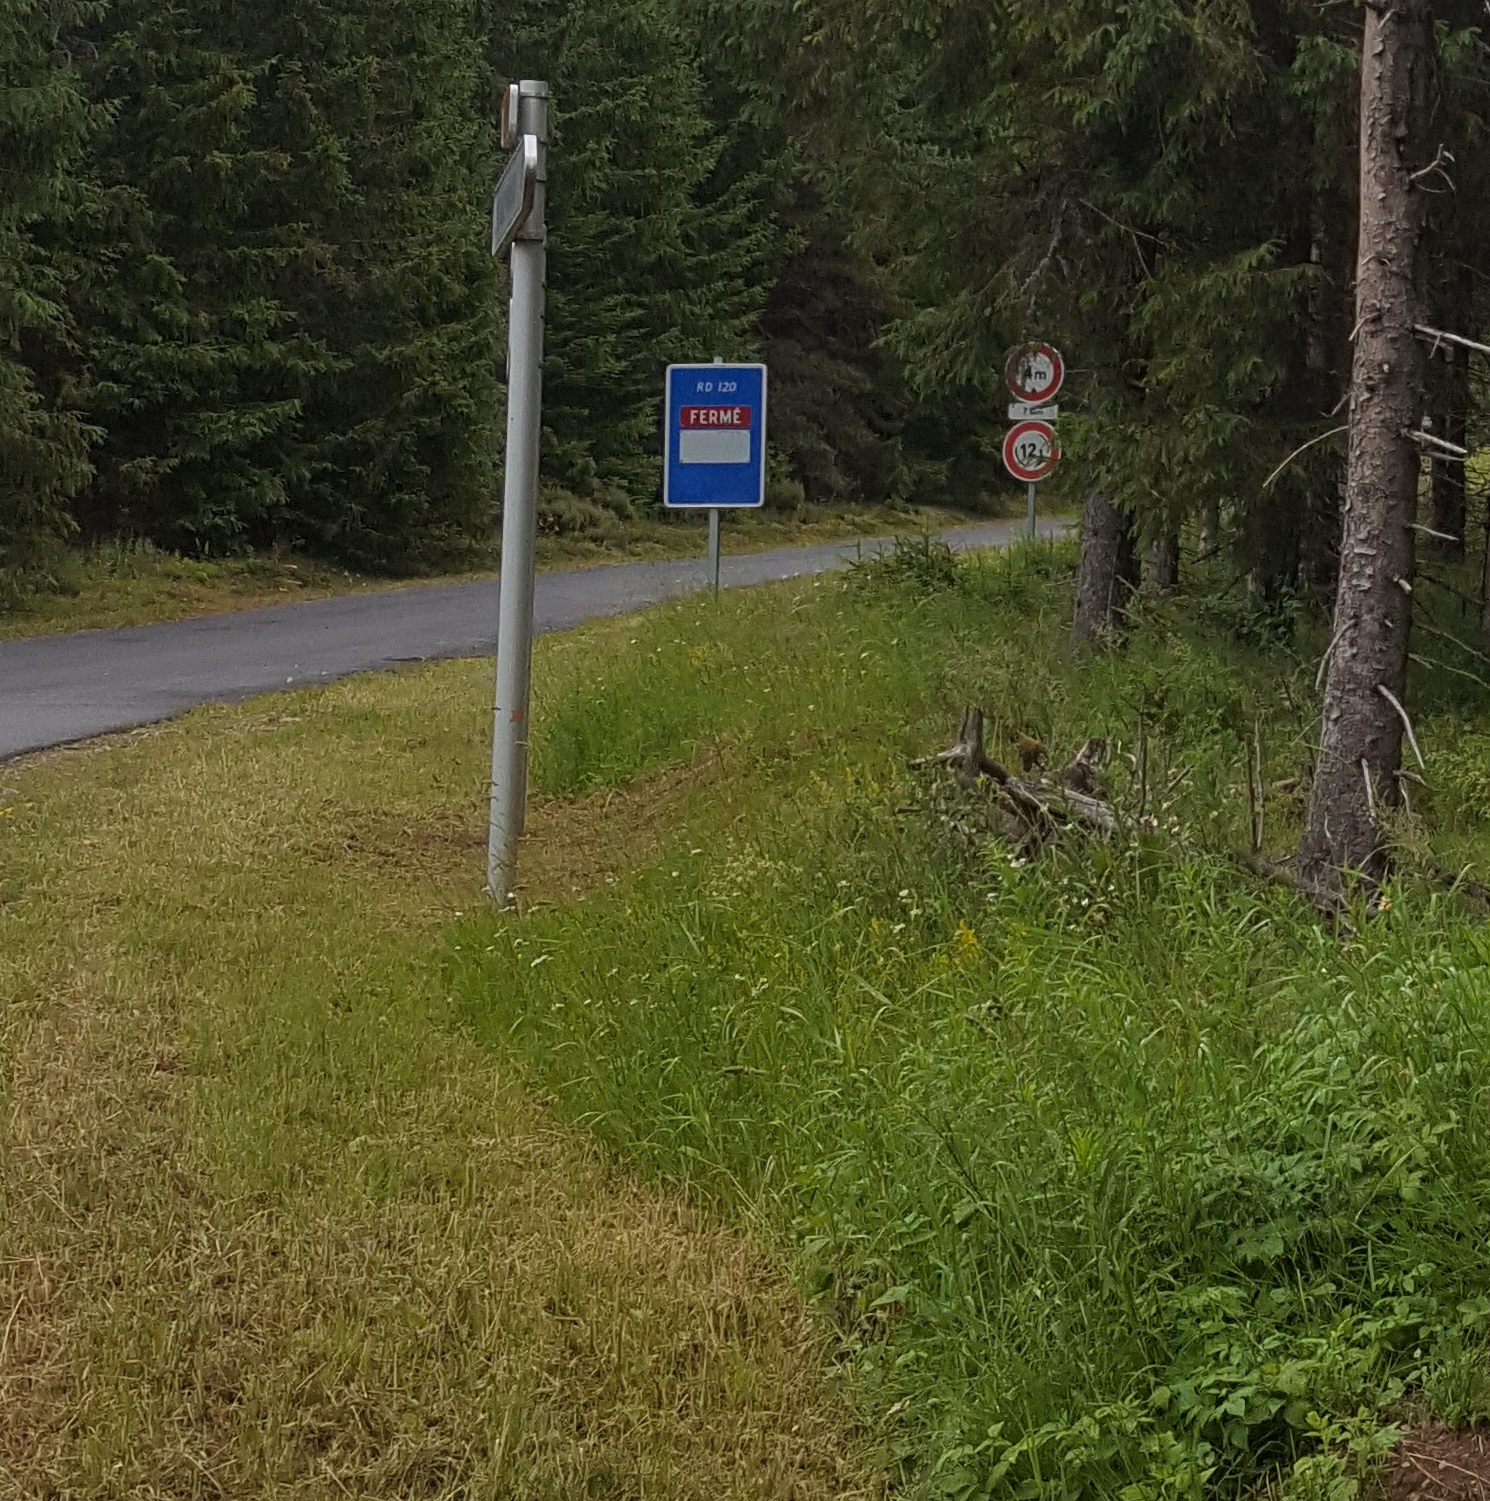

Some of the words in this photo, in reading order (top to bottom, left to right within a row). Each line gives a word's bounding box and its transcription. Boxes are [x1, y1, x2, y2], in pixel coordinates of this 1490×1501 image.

[696, 382, 713, 392] RD
[718, 381, 737, 392] 120
[689, 407, 742, 425] FERMÉ
